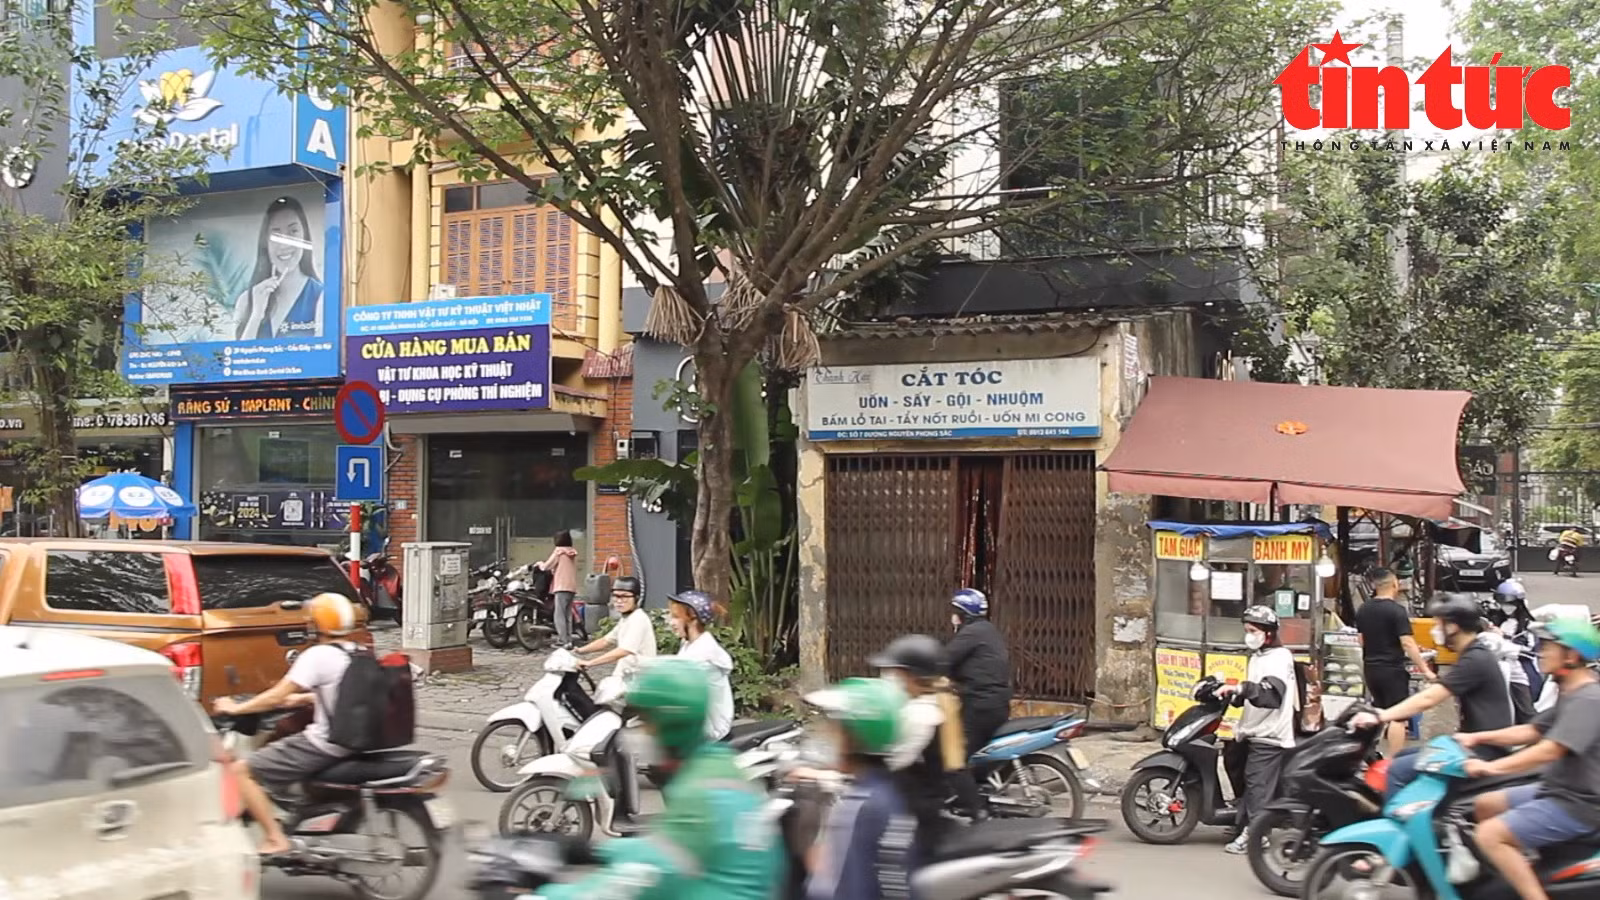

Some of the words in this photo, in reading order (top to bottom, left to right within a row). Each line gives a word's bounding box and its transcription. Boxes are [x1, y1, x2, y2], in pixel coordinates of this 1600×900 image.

[353, 310, 380, 322] CÔNG
[382, 311, 393, 321] TY
[394, 309, 418, 319] TNHH
[419, 306, 437, 319] VẬT
[464, 302, 493, 316] THUẬT
[495, 300, 514, 314] VIỆT
[515, 298, 541, 313] NHẬT
[361, 337, 396, 359] CỬA
[399, 336, 447, 357] HÀNG
[450, 337, 490, 355] MUA
[493, 331, 531, 353] BÁN
[377, 366, 396, 384] VẬT
[398, 366, 412, 381] TƯ
[412, 365, 440, 380] KHOA
[441, 364, 463, 382] HỌC
[480, 360, 513, 380] THUẬT
[901, 366, 948, 387] CẮT
[955, 367, 1003, 386] TÓC
[397, 388, 427, 404] DỤNG
[427, 387, 443, 404] CỤ
[443, 384, 479, 401] PHÒNG
[480, 383, 498, 399] THÍ
[499, 381, 542, 400] NGHIỆM
[859, 393, 889, 409] UỐN
[903, 392, 931, 407] SẤY
[946, 392, 972, 408] GỘI
[986, 391, 1043, 407] NHUỘM
[177, 399, 212, 414] RĂNG
[214, 397, 231, 413] SỨ
[821, 413, 848, 426] BẤM
[869, 416, 887, 425] TAI
[897, 410, 919, 424] TẨY
[922, 411, 948, 424] NỐT
[993, 410, 1021, 423] UỐN
[1025, 413, 1040, 422] MI
[1044, 412, 1086, 422] CONG
[237, 507, 261, 519] 2024
[1158, 537, 1177, 556] TAM
